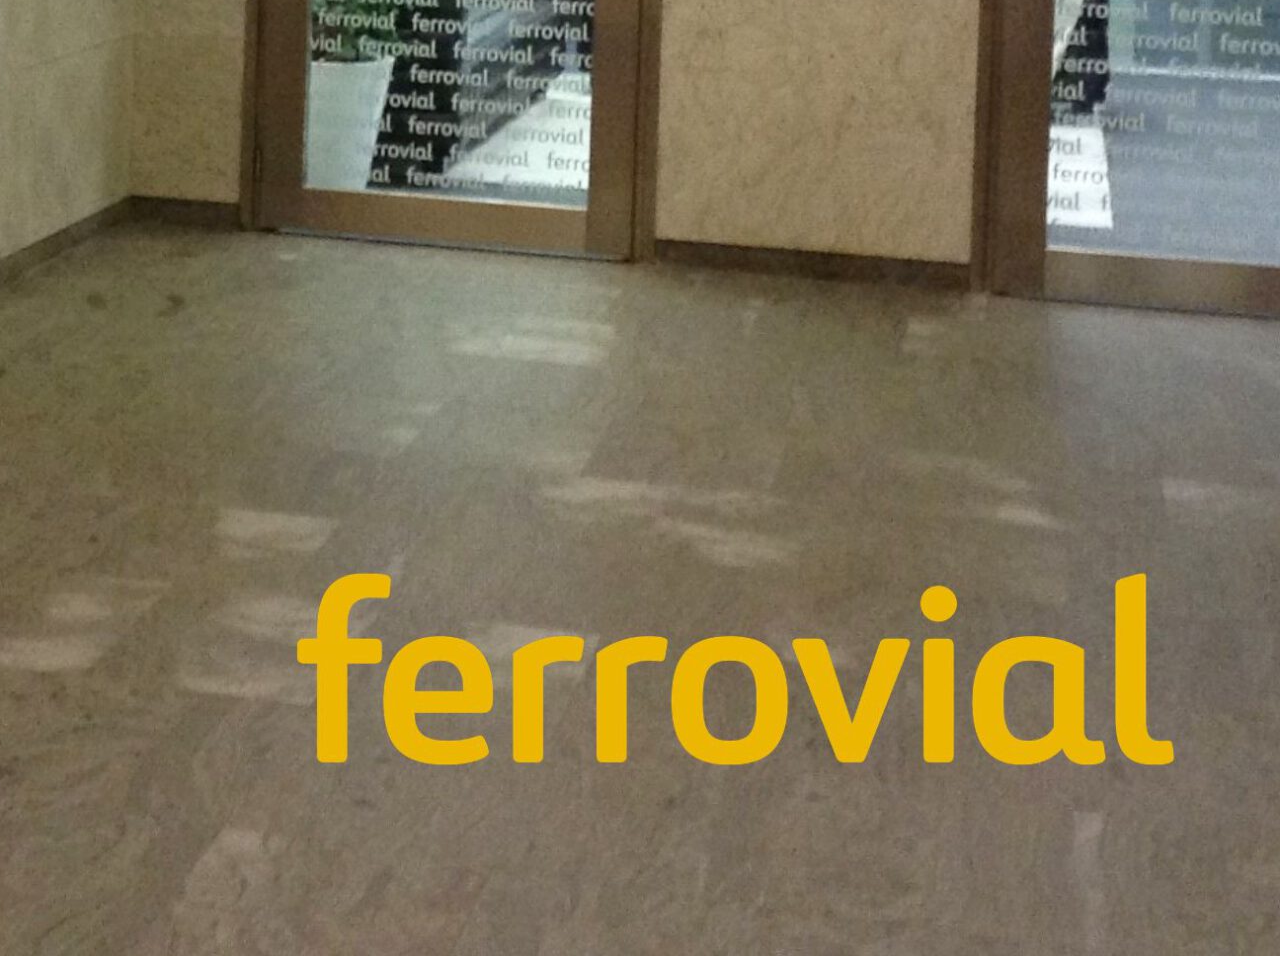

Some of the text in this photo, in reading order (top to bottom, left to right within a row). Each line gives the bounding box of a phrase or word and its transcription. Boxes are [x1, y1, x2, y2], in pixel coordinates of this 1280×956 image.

[318, 6, 590, 42] ferrovial ferrov ferrovial
[1170, 0, 1263, 27] ferrovial
[358, 34, 438, 59] ferrovial
[453, 40, 535, 65] ferrovial
[410, 63, 489, 89] ferrovial
[451, 93, 531, 117] ferrovial
[408, 114, 488, 139] ferrovial
[406, 165, 486, 191] ferrovial
